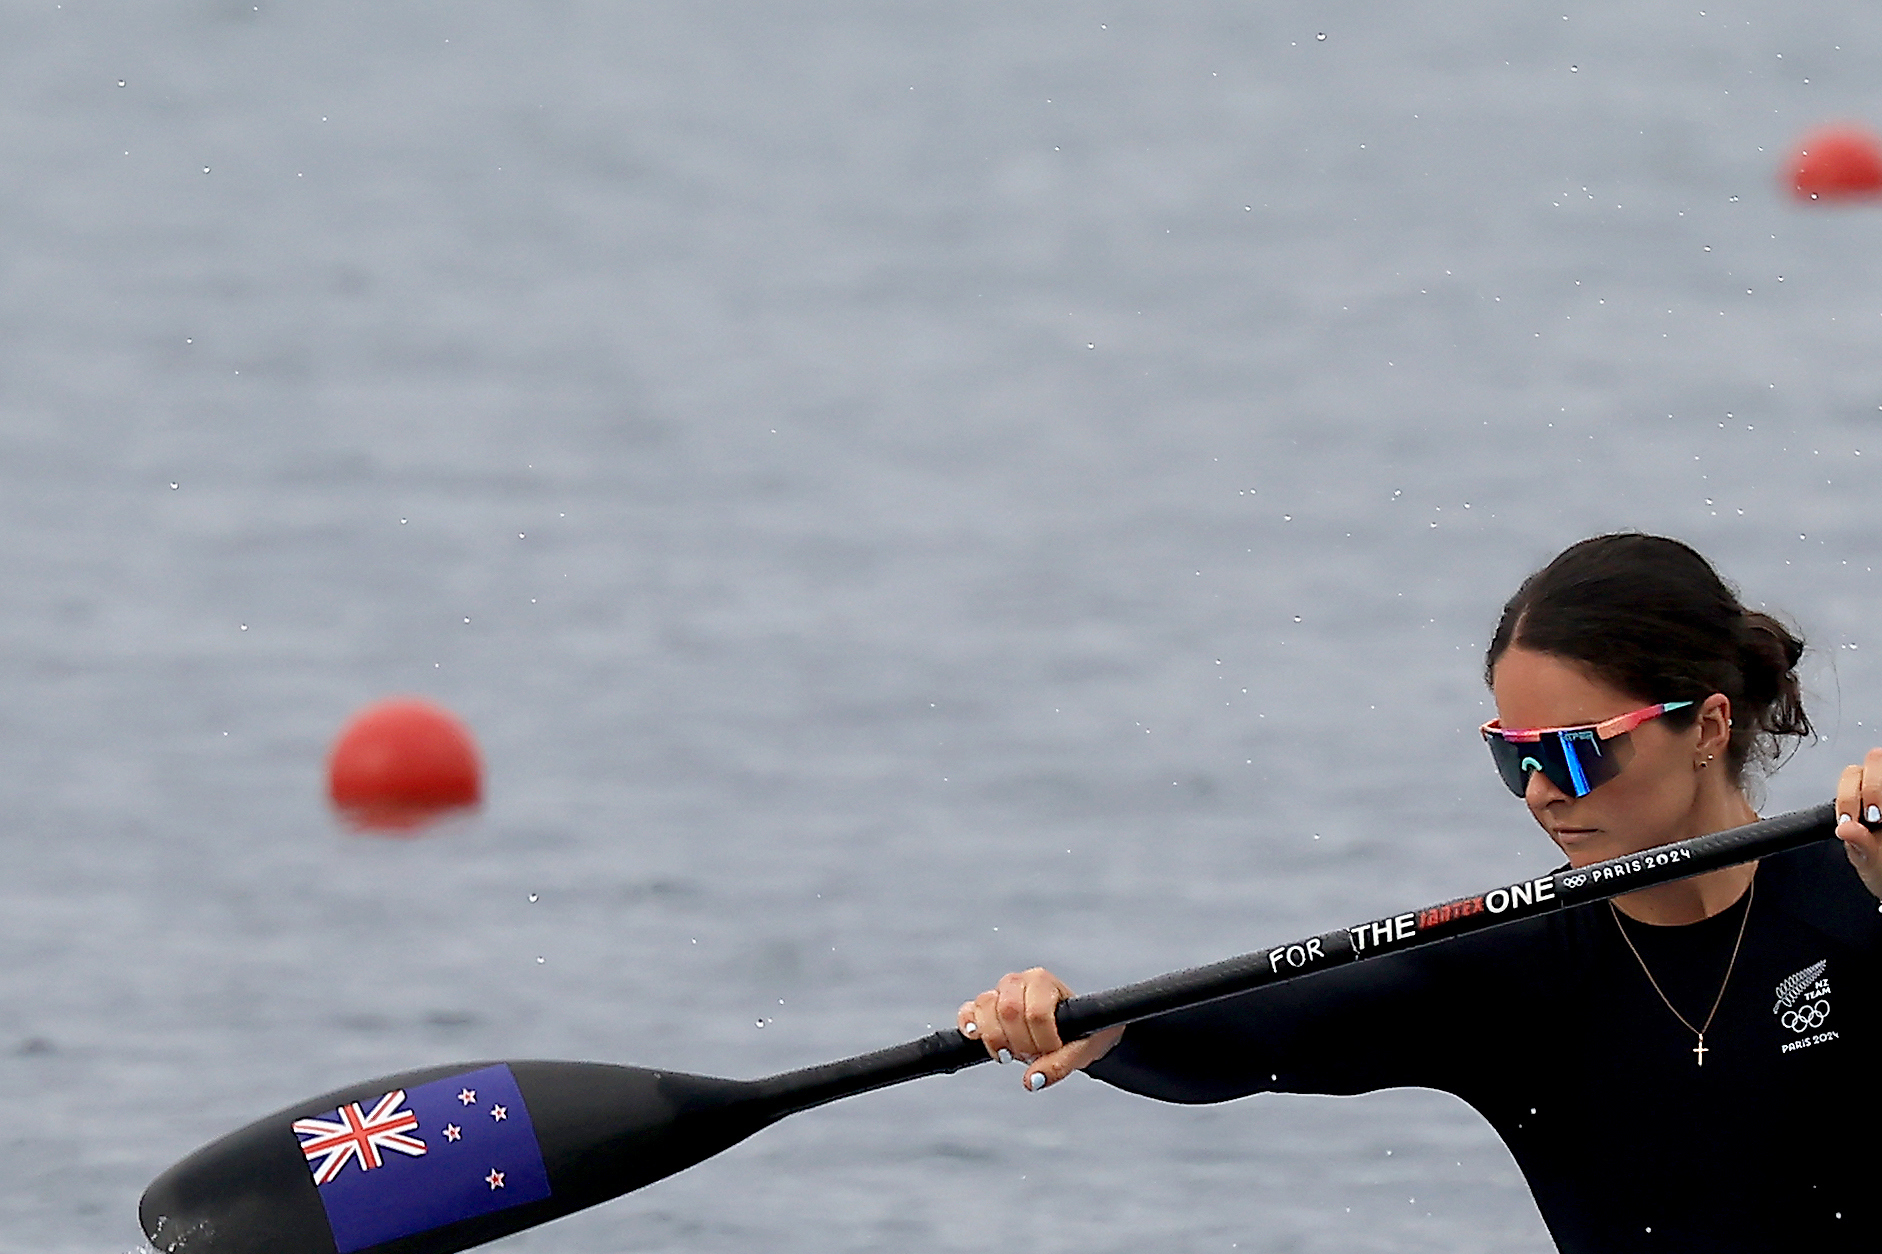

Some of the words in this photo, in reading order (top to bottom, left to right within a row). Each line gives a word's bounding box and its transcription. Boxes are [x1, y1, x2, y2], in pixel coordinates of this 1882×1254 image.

[1268, 937, 1325, 974] FOR
[1350, 912, 1416, 951] THE
[1485, 876, 1556, 914] ONE
[1645, 848, 1692, 870] 2024
[1814, 979, 1830, 990] NZ
[1804, 987, 1831, 1001] TEAM
[1812, 1031, 1840, 1045] 2024
